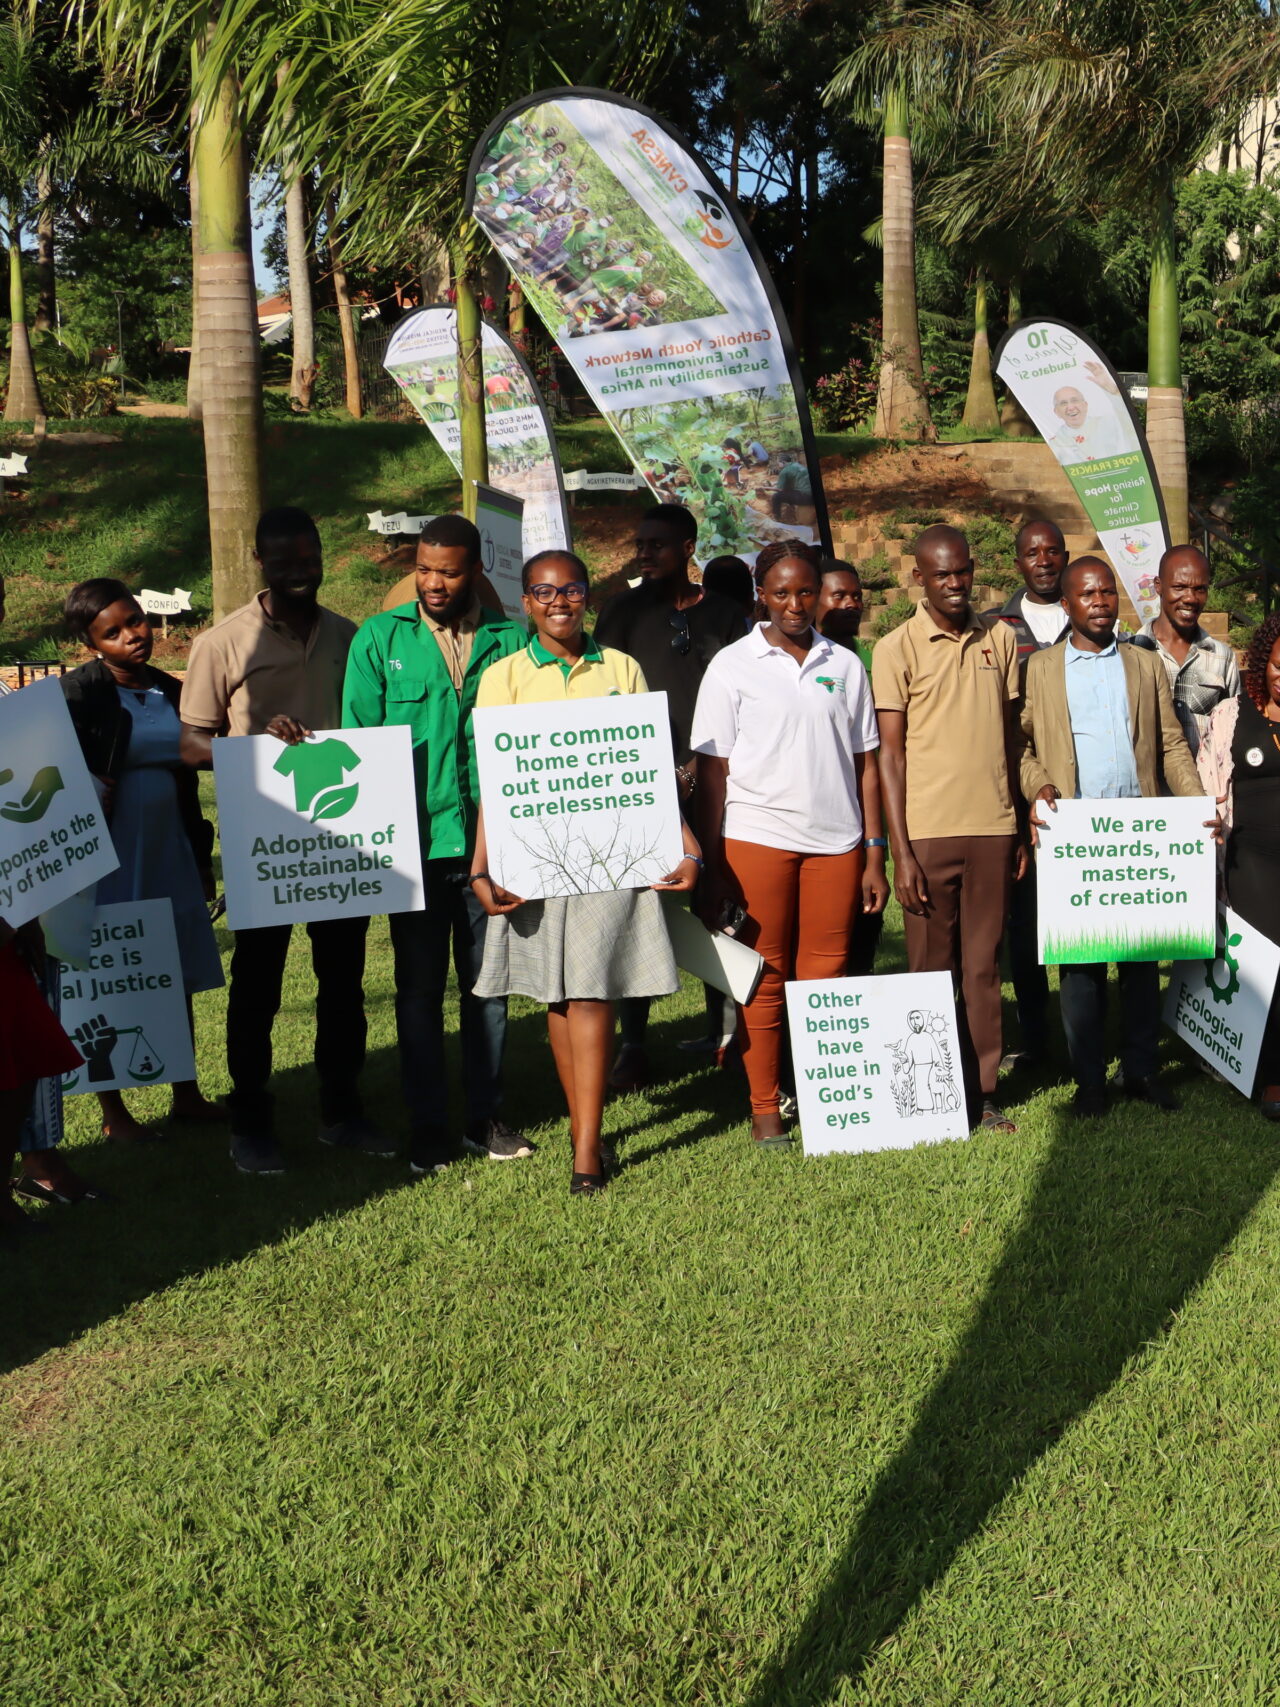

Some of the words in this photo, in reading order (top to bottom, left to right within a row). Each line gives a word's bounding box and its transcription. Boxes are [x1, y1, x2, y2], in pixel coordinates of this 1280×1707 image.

[382, 521, 400, 531] YEZU
[494, 732, 541, 752] Our
[550, 723, 655, 747] common
[516, 754, 578, 773] home
[587, 747, 640, 766] cries
[502, 778, 540, 797] out
[548, 772, 613, 792] under
[621, 769, 658, 785] our
[510, 791, 655, 818] carelessness
[1091, 817, 1124, 833] We
[1131, 819, 1167, 832] are
[0, 839, 49, 880] ponse
[51, 829, 68, 847] to
[70, 813, 96, 836] the
[251, 831, 364, 857] Adoption
[371, 824, 395, 845] of
[1053, 840, 1160, 859] stewards,
[1168, 839, 1204, 856] not
[17, 867, 34, 893] of
[36, 859, 63, 882] the
[64, 836, 99, 867] Poor
[256, 851, 393, 881] Sustainable
[1082, 866, 1176, 882] masters,
[273, 877, 382, 904] Lifestyles
[1070, 889, 1092, 907] of
[1098, 888, 1187, 906] creation
[90, 919, 144, 948] gical
[122, 947, 142, 966] is
[90, 972, 172, 1001] Justice
[808, 992, 862, 1009] Other
[806, 1015, 870, 1034] beings
[1179, 982, 1243, 1051] Ecological
[817, 1040, 863, 1056] have
[1175, 1002, 1242, 1074] Economics
[804, 1062, 857, 1080] value
[864, 1058, 880, 1076] in
[818, 1085, 873, 1103] God's
[826, 1111, 870, 1130] eyes
